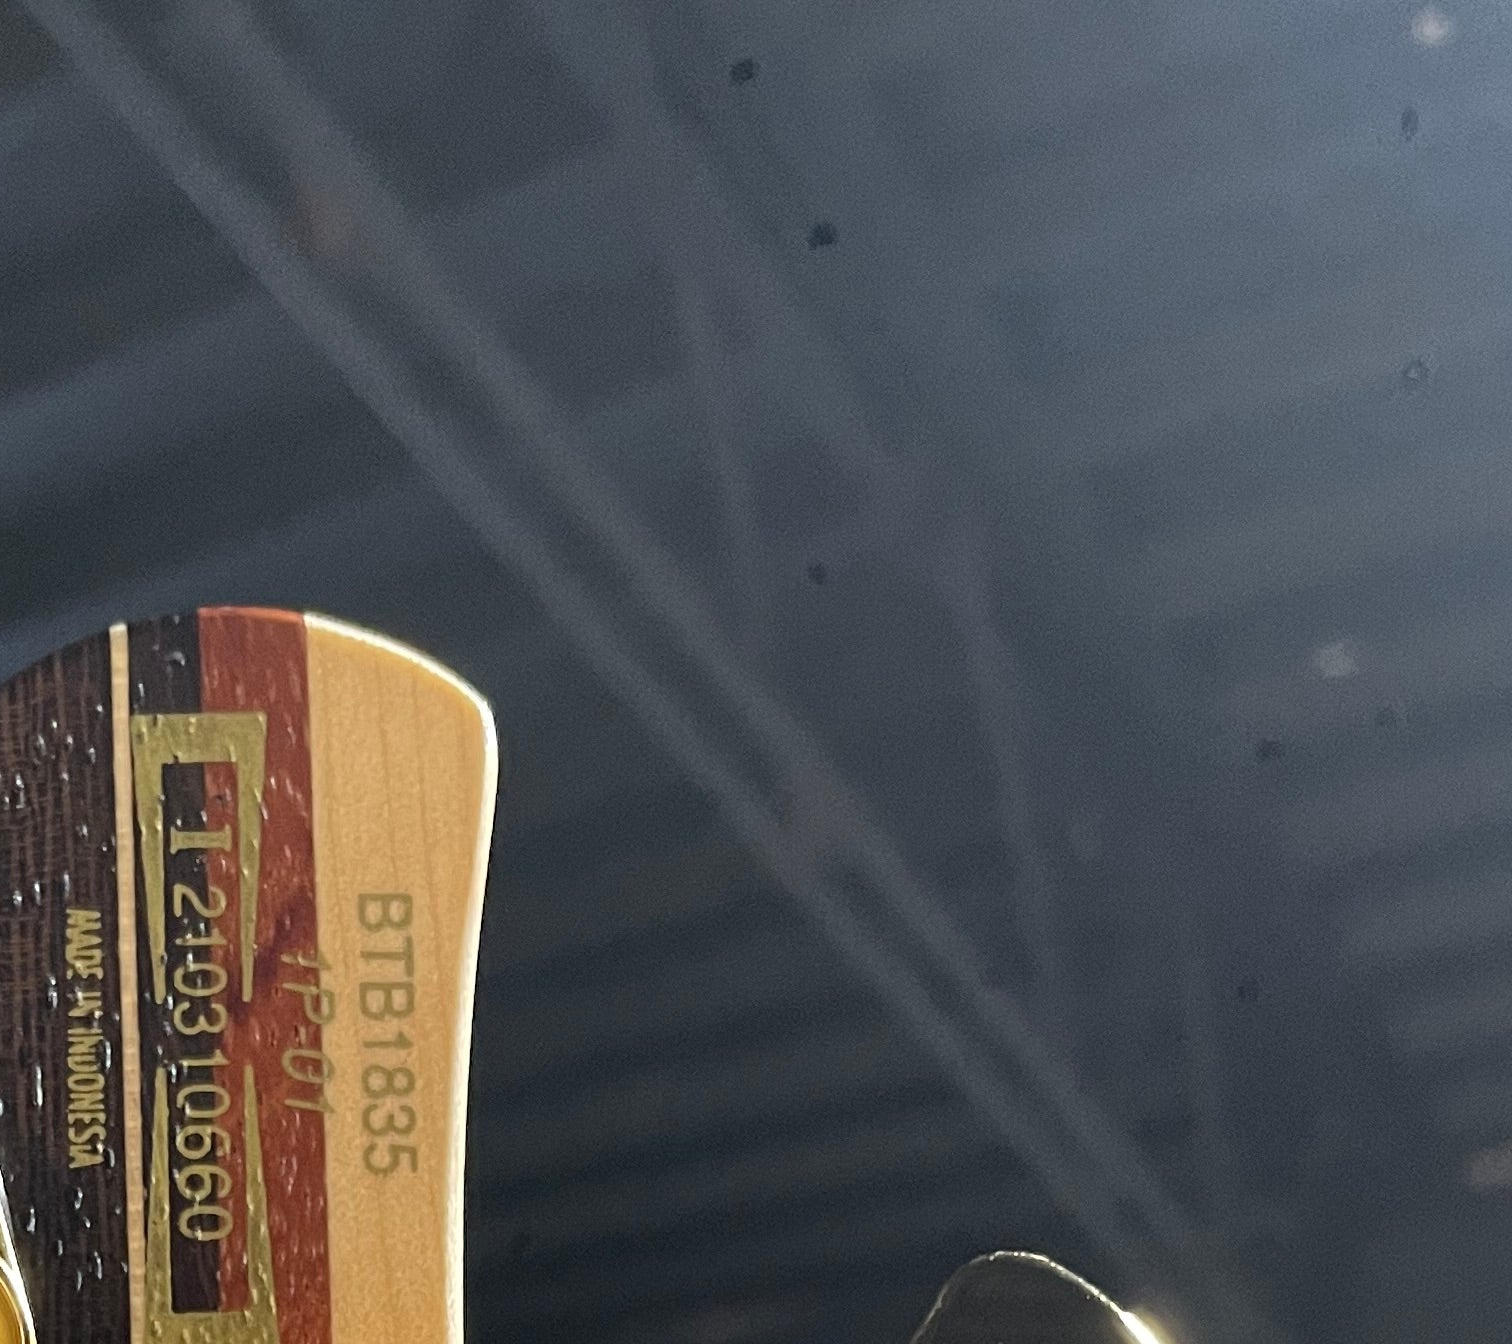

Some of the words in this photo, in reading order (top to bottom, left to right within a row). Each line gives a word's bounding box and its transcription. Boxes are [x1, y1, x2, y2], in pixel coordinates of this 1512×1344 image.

[66, 908, 102, 979] MADE
[67, 991, 104, 1017] IN
[68, 1029, 107, 1169] INDONESIA
[281, 953, 338, 1113] 1P-01
[357, 892, 418, 1178] BTB1835
